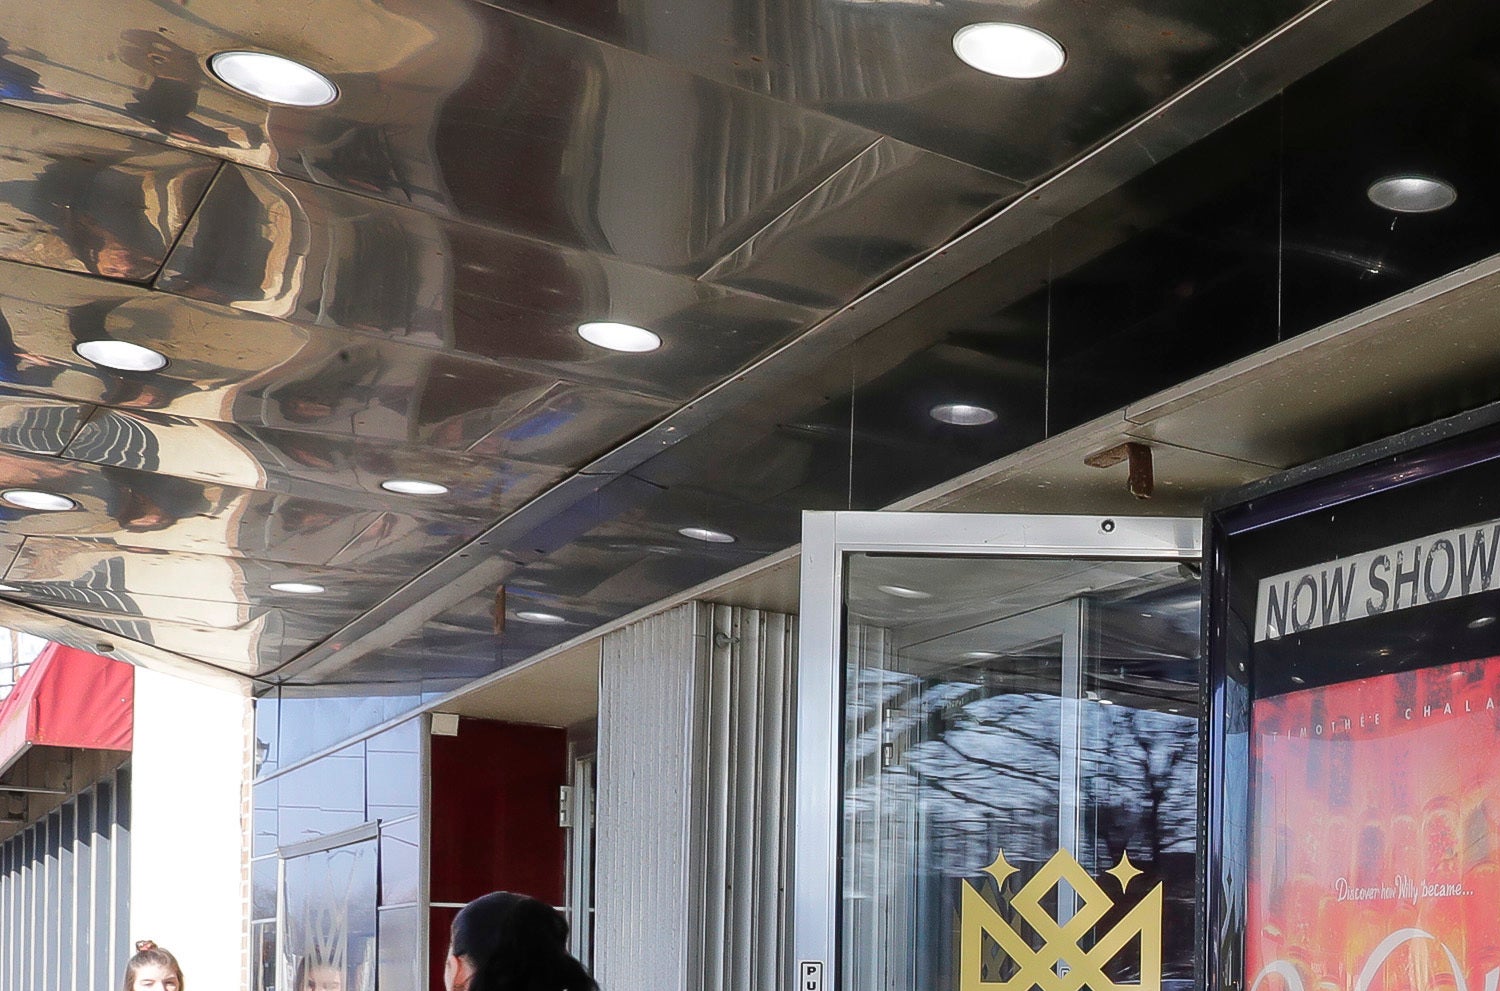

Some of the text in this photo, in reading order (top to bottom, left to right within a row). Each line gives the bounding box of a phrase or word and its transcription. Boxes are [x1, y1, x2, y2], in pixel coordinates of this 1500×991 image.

[1267, 562, 1356, 641] NOW
[1335, 877, 1380, 902] Discover
[1395, 875, 1419, 905] Willy
